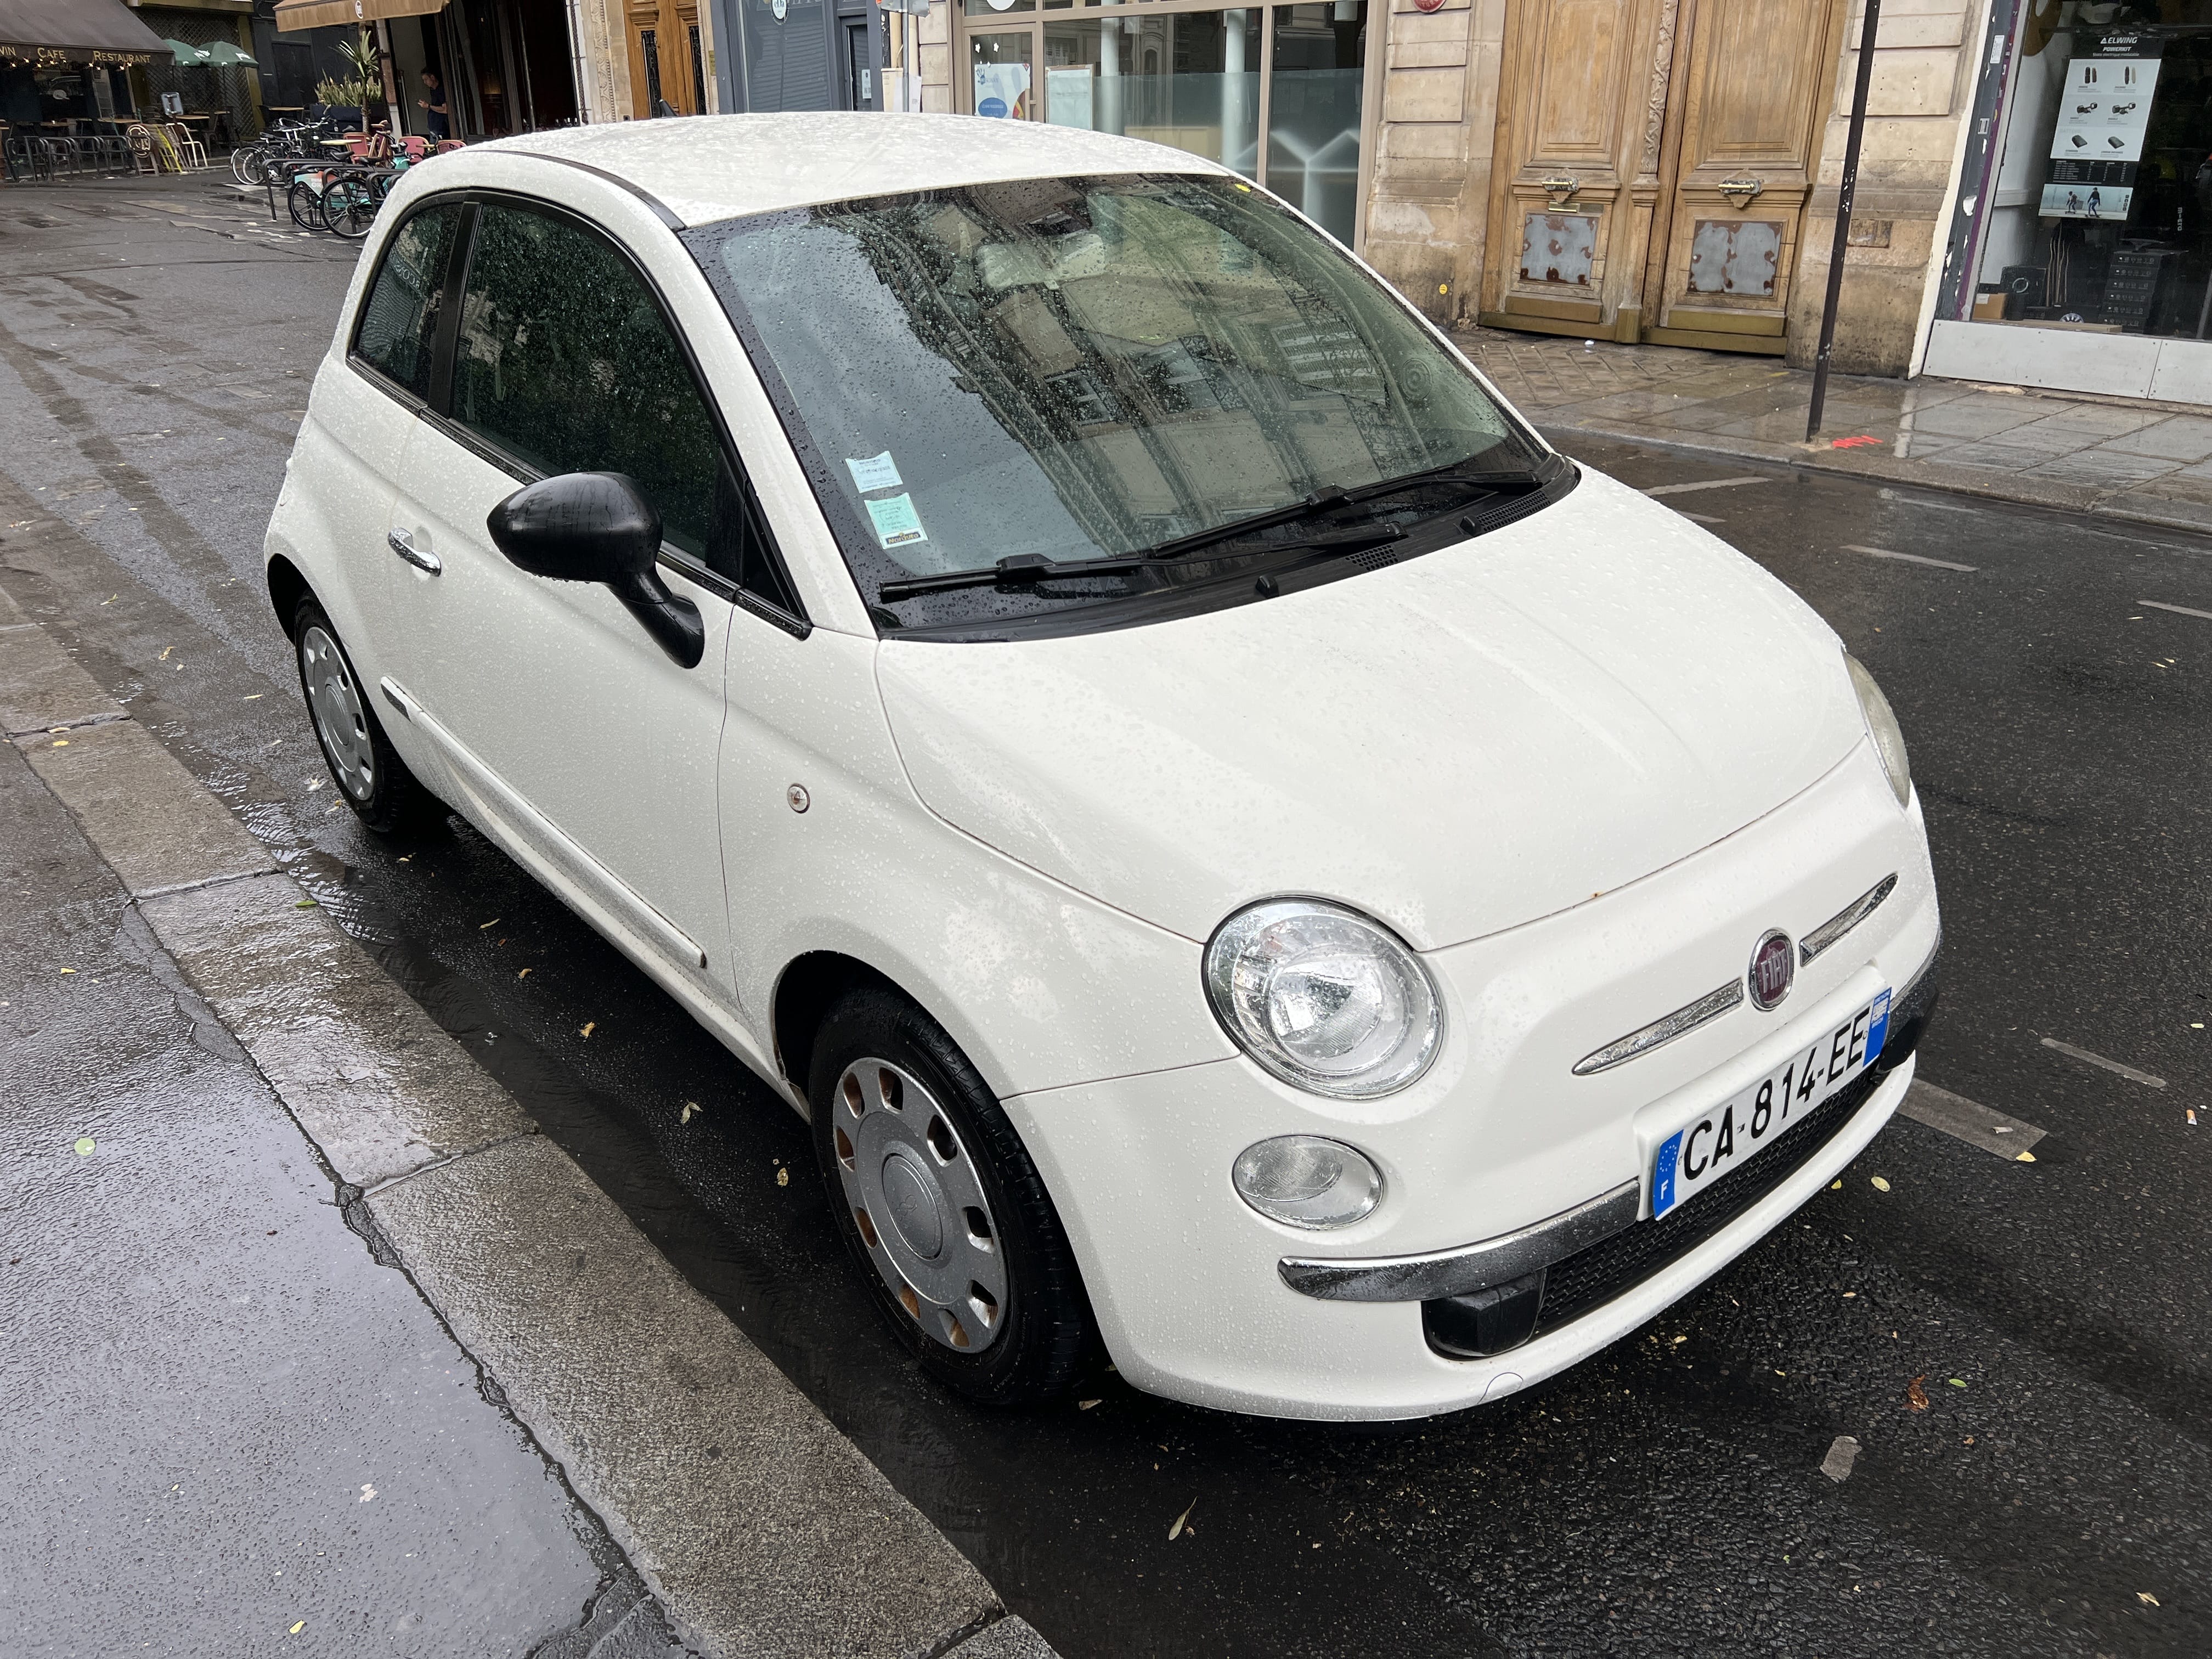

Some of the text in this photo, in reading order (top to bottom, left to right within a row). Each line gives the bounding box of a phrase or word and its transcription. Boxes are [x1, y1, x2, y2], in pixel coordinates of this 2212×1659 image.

[93, 50, 151, 63] RESTAURANT
[1760, 948, 1786, 994] FIAT
[1684, 1006, 1870, 1180] CA-814-EE
[1661, 1180, 1667, 1200] F
